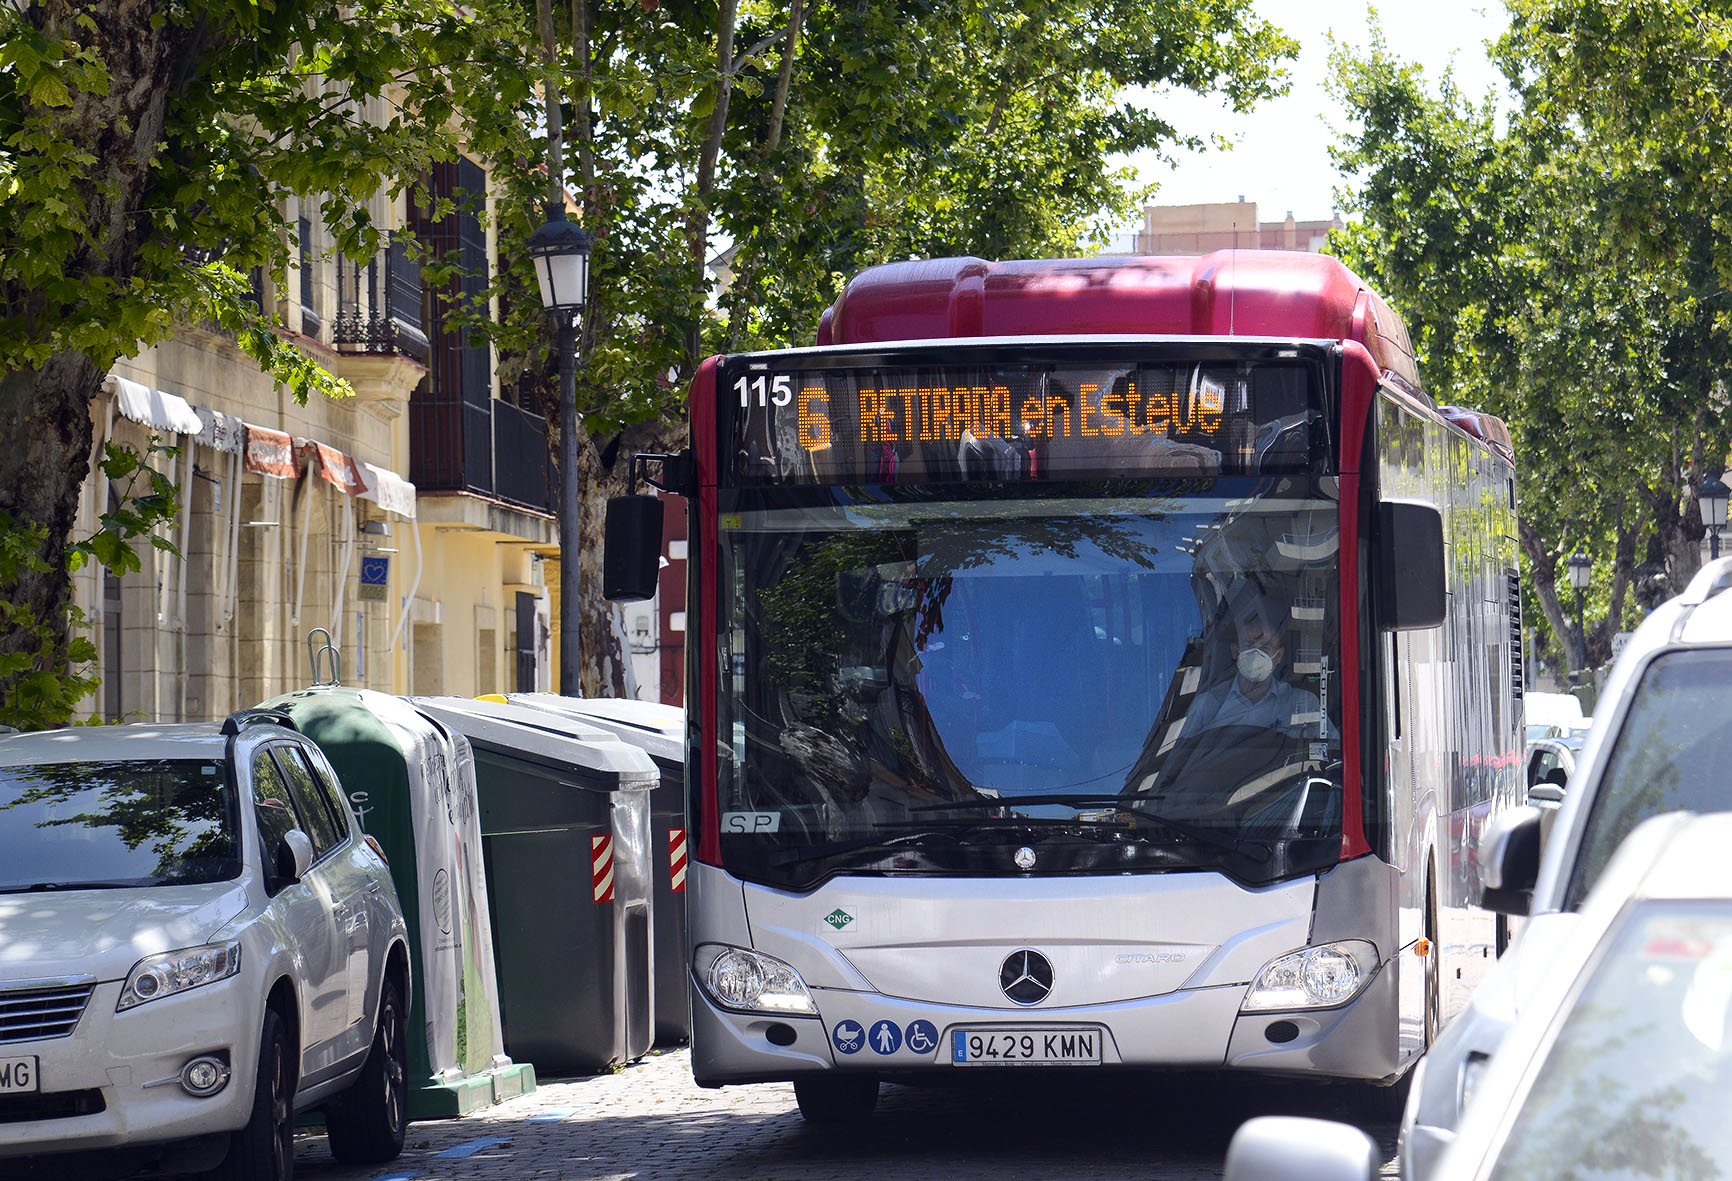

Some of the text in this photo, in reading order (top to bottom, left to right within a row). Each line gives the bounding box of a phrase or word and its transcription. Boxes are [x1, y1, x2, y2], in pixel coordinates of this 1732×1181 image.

[733, 375, 793, 408] 115
[798, 382, 1223, 451] 6 RETIRADA en Esteve
[827, 914, 850, 924] CNG
[1115, 952, 1186, 964] CITARO
[969, 1035, 1035, 1059] 9429
[1043, 1034, 1094, 1058] KMN
